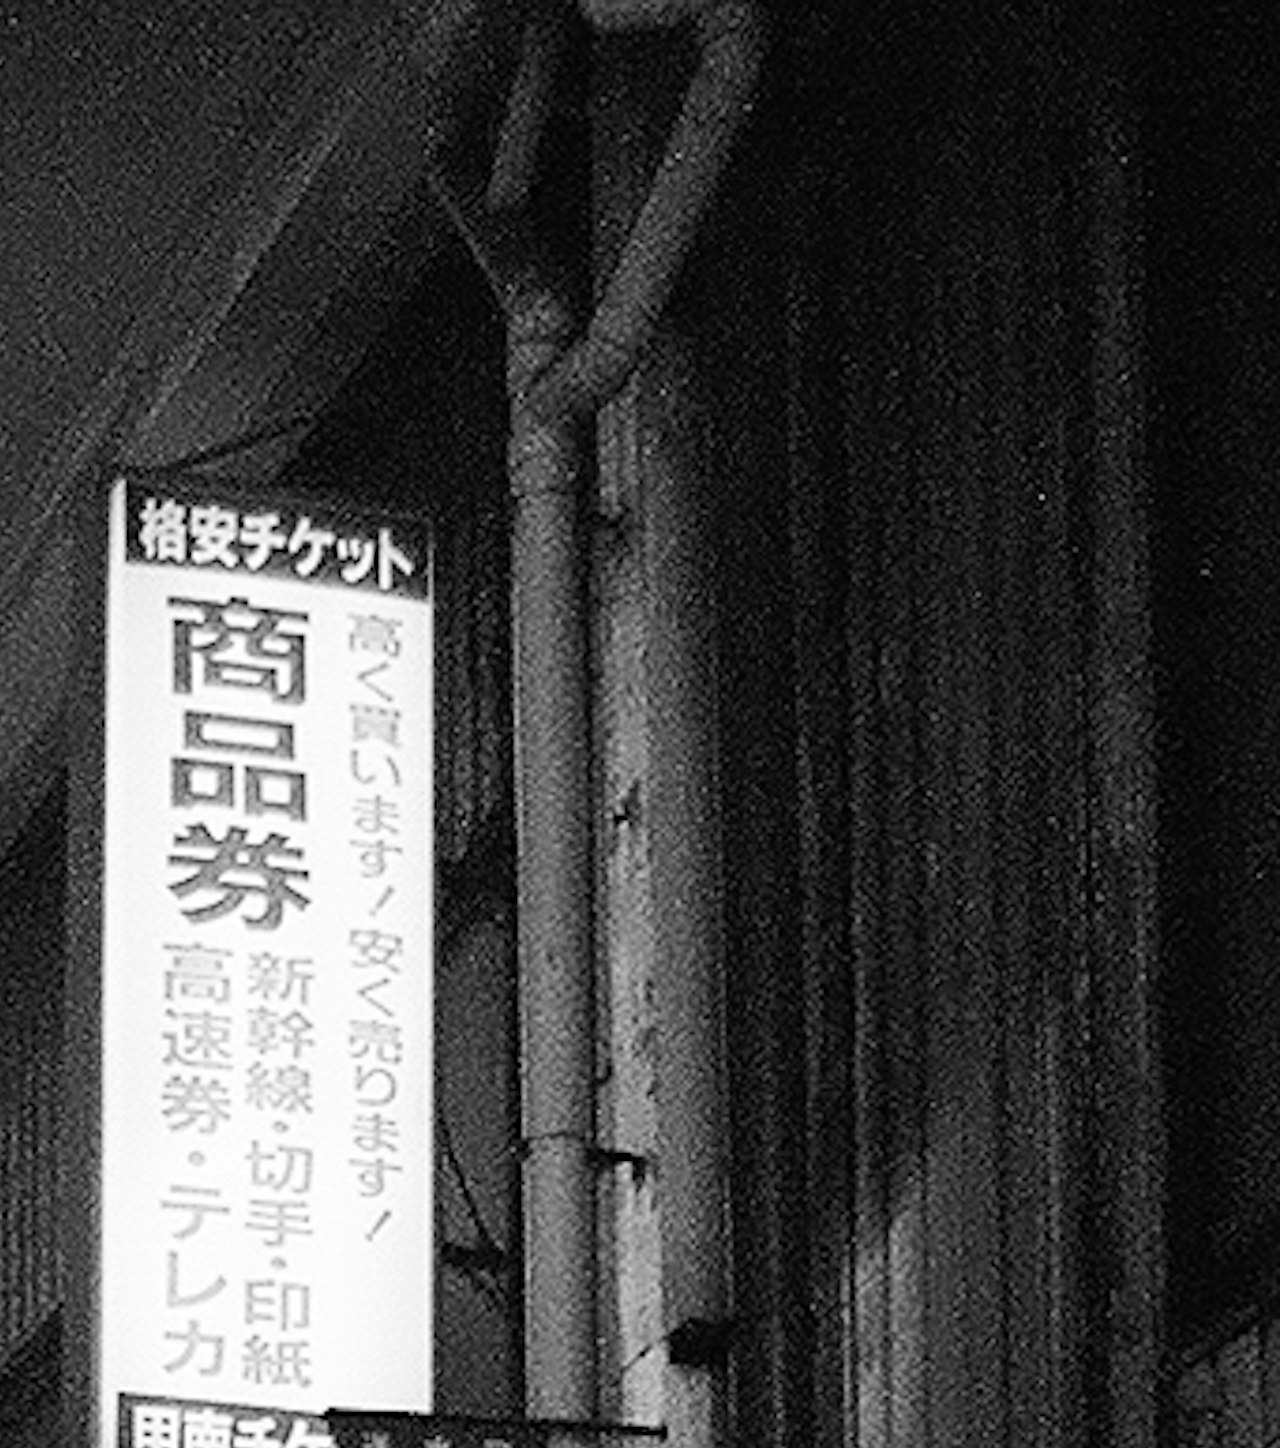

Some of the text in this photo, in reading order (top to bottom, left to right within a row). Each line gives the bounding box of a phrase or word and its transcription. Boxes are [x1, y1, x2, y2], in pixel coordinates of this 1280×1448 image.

[140, 498, 414, 592] 格安チケット
[166, 595, 313, 932] 商品券
[161, 942, 235, 1378] 高速券・テレカ
[241, 951, 314, 1388] 新幹線・切手・印紙
